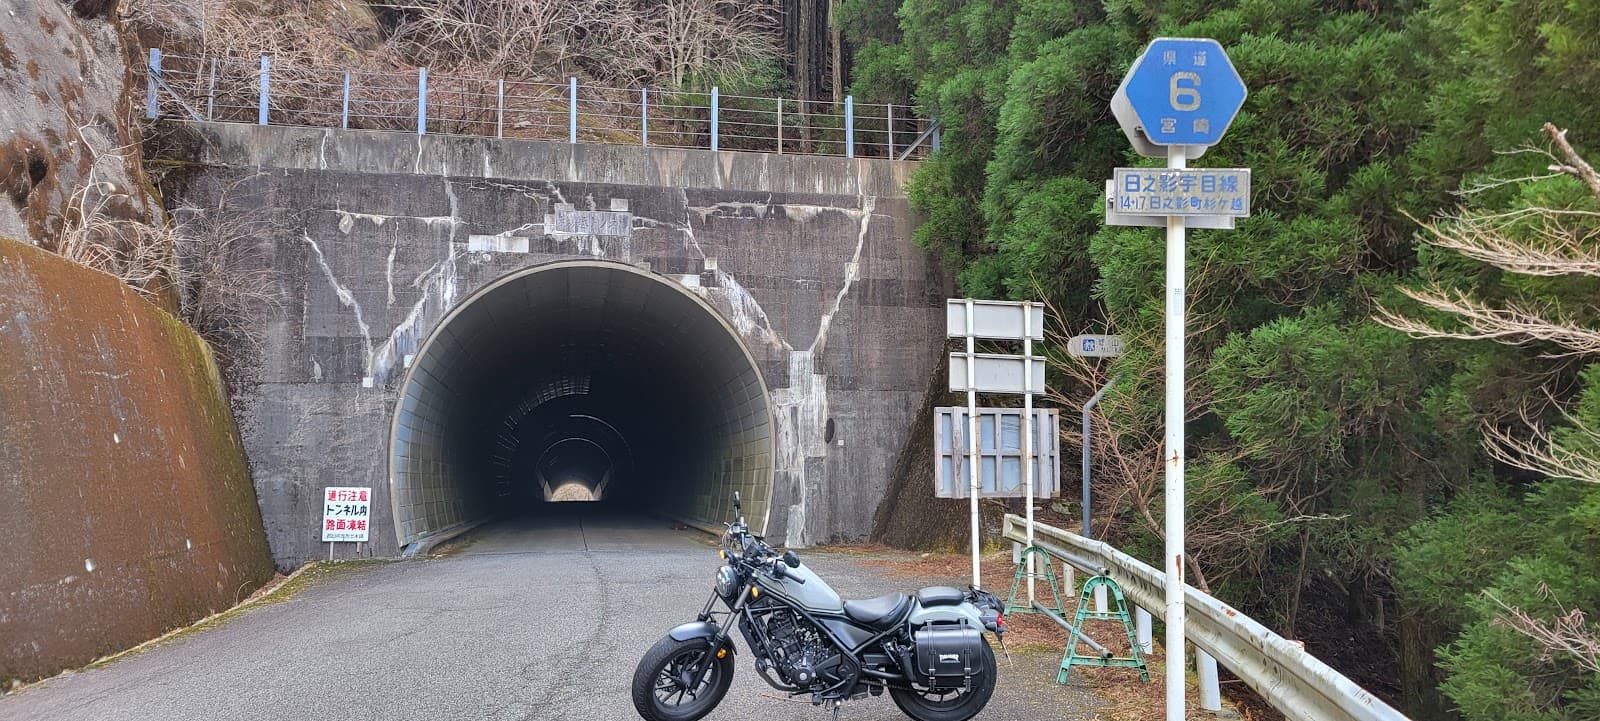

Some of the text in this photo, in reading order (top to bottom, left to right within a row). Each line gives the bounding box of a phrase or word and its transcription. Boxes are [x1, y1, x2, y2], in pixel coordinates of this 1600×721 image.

[1163, 50, 1207, 66] 県道
[1169, 71, 1202, 112] 6
[1125, 174, 1238, 193] 日之影宇目線
[328, 490, 368, 502] 通行注意
[326, 504, 367, 516] トンネル内
[326, 519, 367, 531] 路面凍結
